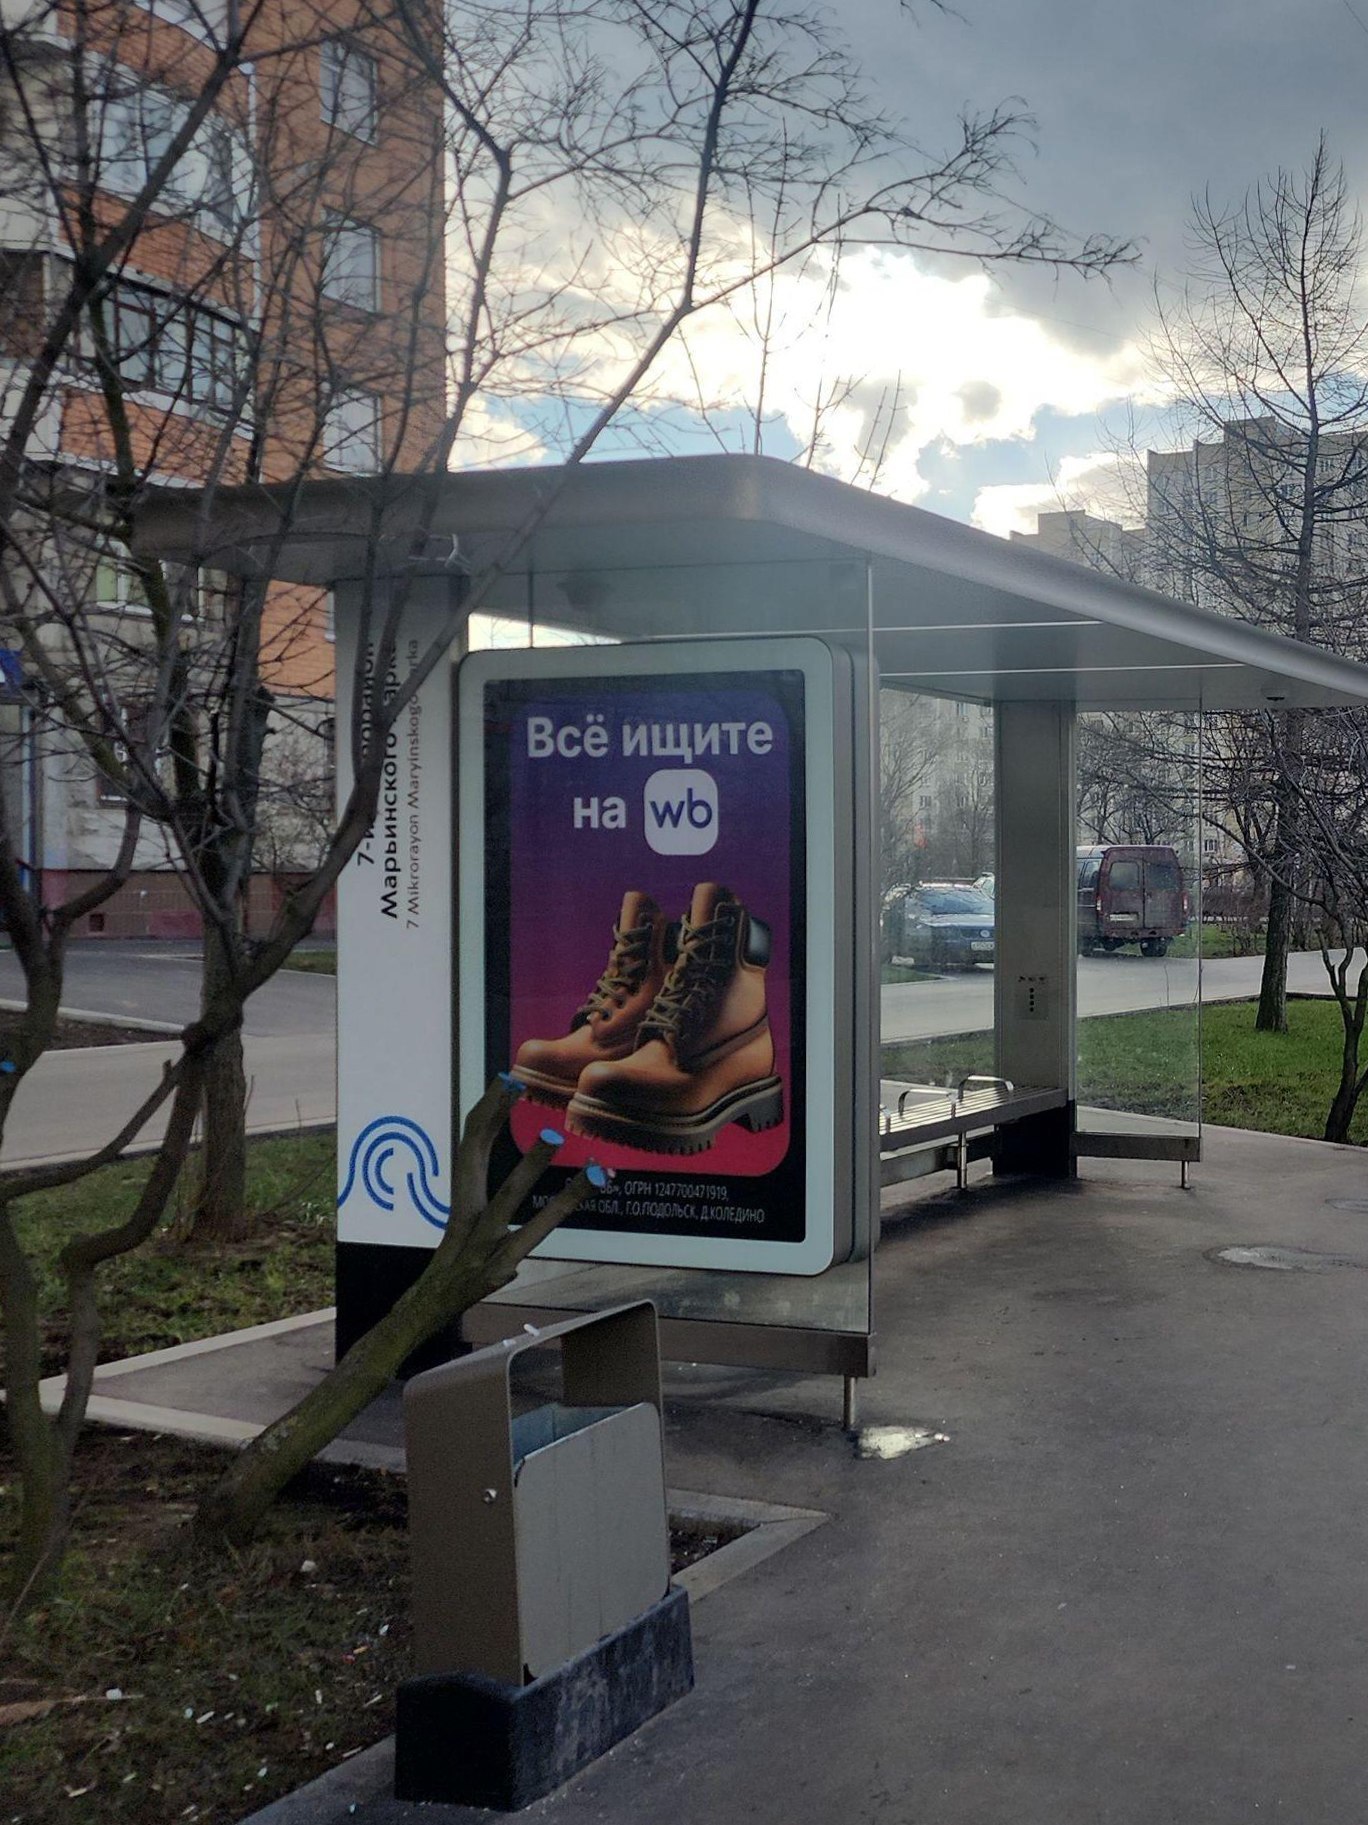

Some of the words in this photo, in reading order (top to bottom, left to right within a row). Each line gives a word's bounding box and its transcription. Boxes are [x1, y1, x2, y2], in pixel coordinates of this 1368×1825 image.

[407, 693, 422, 809] Maryinskogo
[527, 714, 609, 758] Всё
[622, 721, 773, 764] ищите
[380, 732, 401, 919] Марьинского
[573, 796, 626, 829] на
[649, 788, 713, 828] wb
[407, 814, 422, 915] Mikrorayon
[406, 920, 419, 929] 7
[624, 1180, 652, 1196] ОГРН
